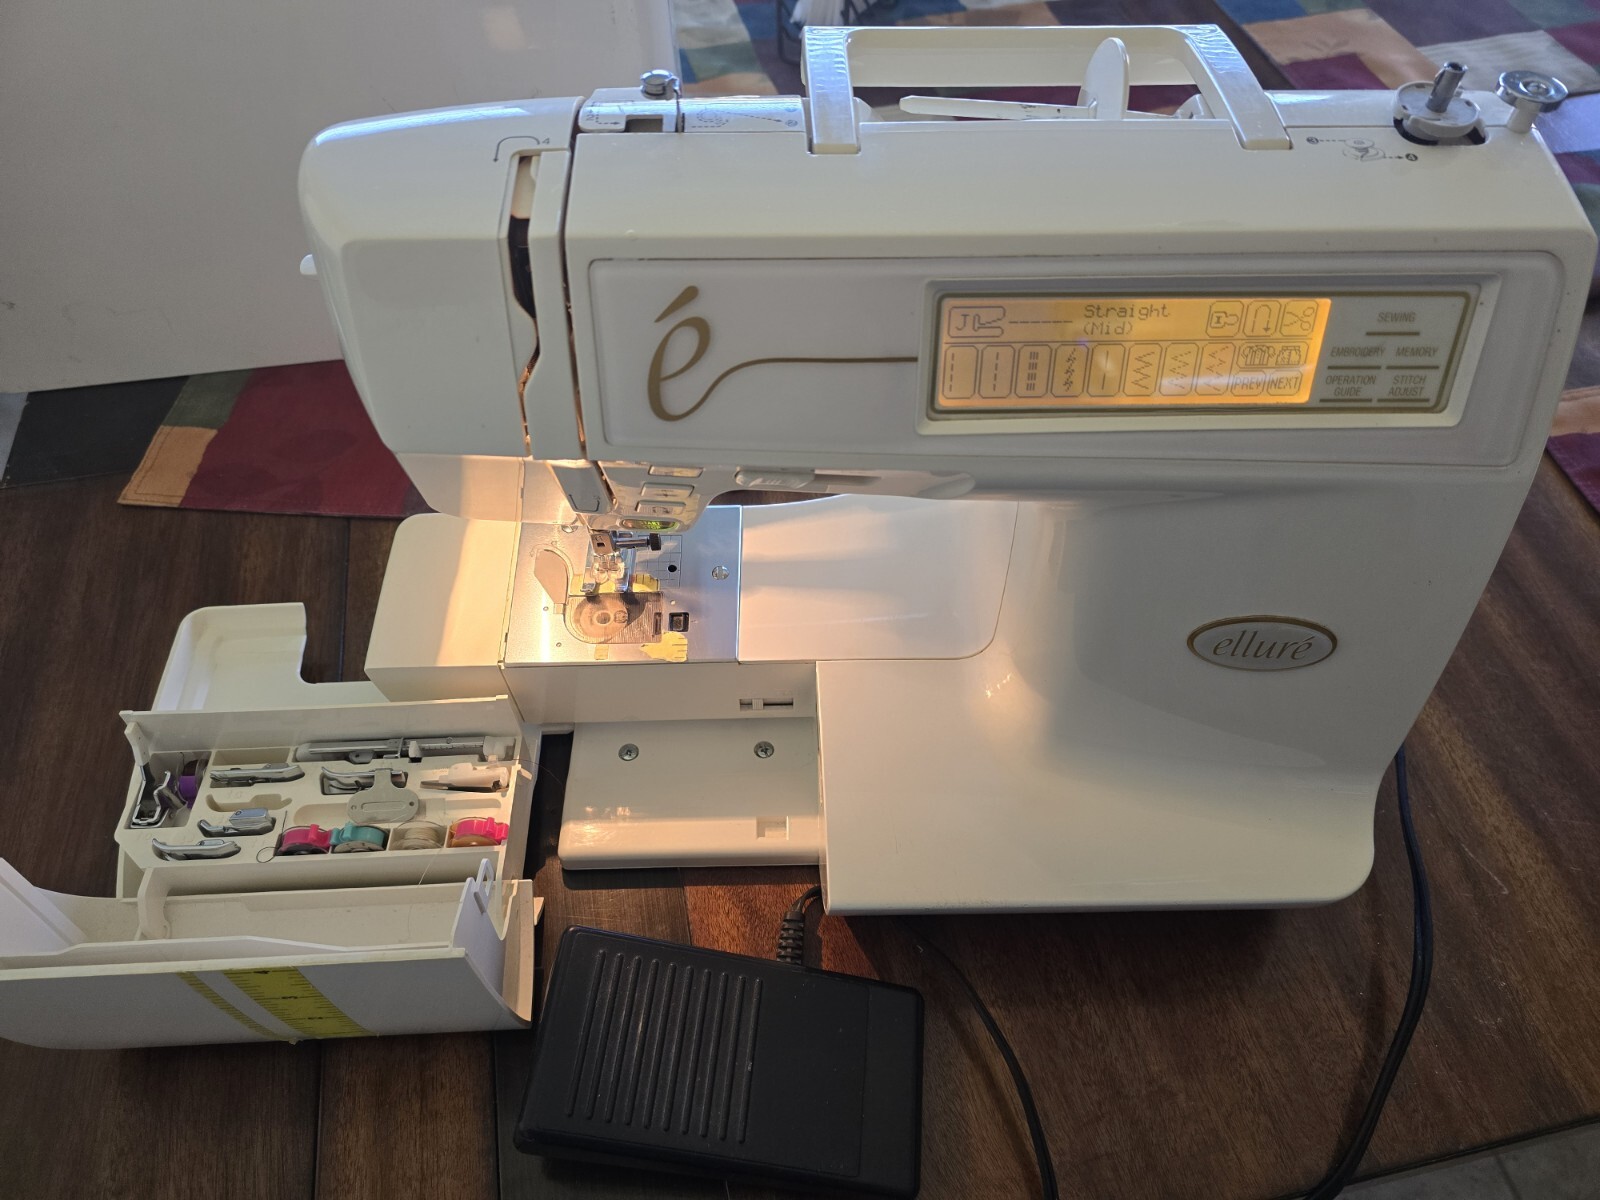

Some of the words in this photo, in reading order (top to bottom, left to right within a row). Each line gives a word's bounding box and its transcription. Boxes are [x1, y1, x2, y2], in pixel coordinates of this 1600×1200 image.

[1083, 303, 1170, 320] Straight
[959, 313, 969, 328] J
[1377, 312, 1416, 323] SEWING
[1083, 322, 1134, 336] (Mid)
[1330, 347, 1386, 357] EMBROIDERY
[1395, 347, 1439, 357] MEMORY
[1268, 375, 1300, 392] NEXT
[1325, 375, 1377, 385] OPERATION
[1393, 375, 1427, 385] STITCH
[1333, 387, 1363, 397] GUIDE
[1388, 387, 1425, 397] ADJUST
[1213, 629, 1316, 661] elluré
